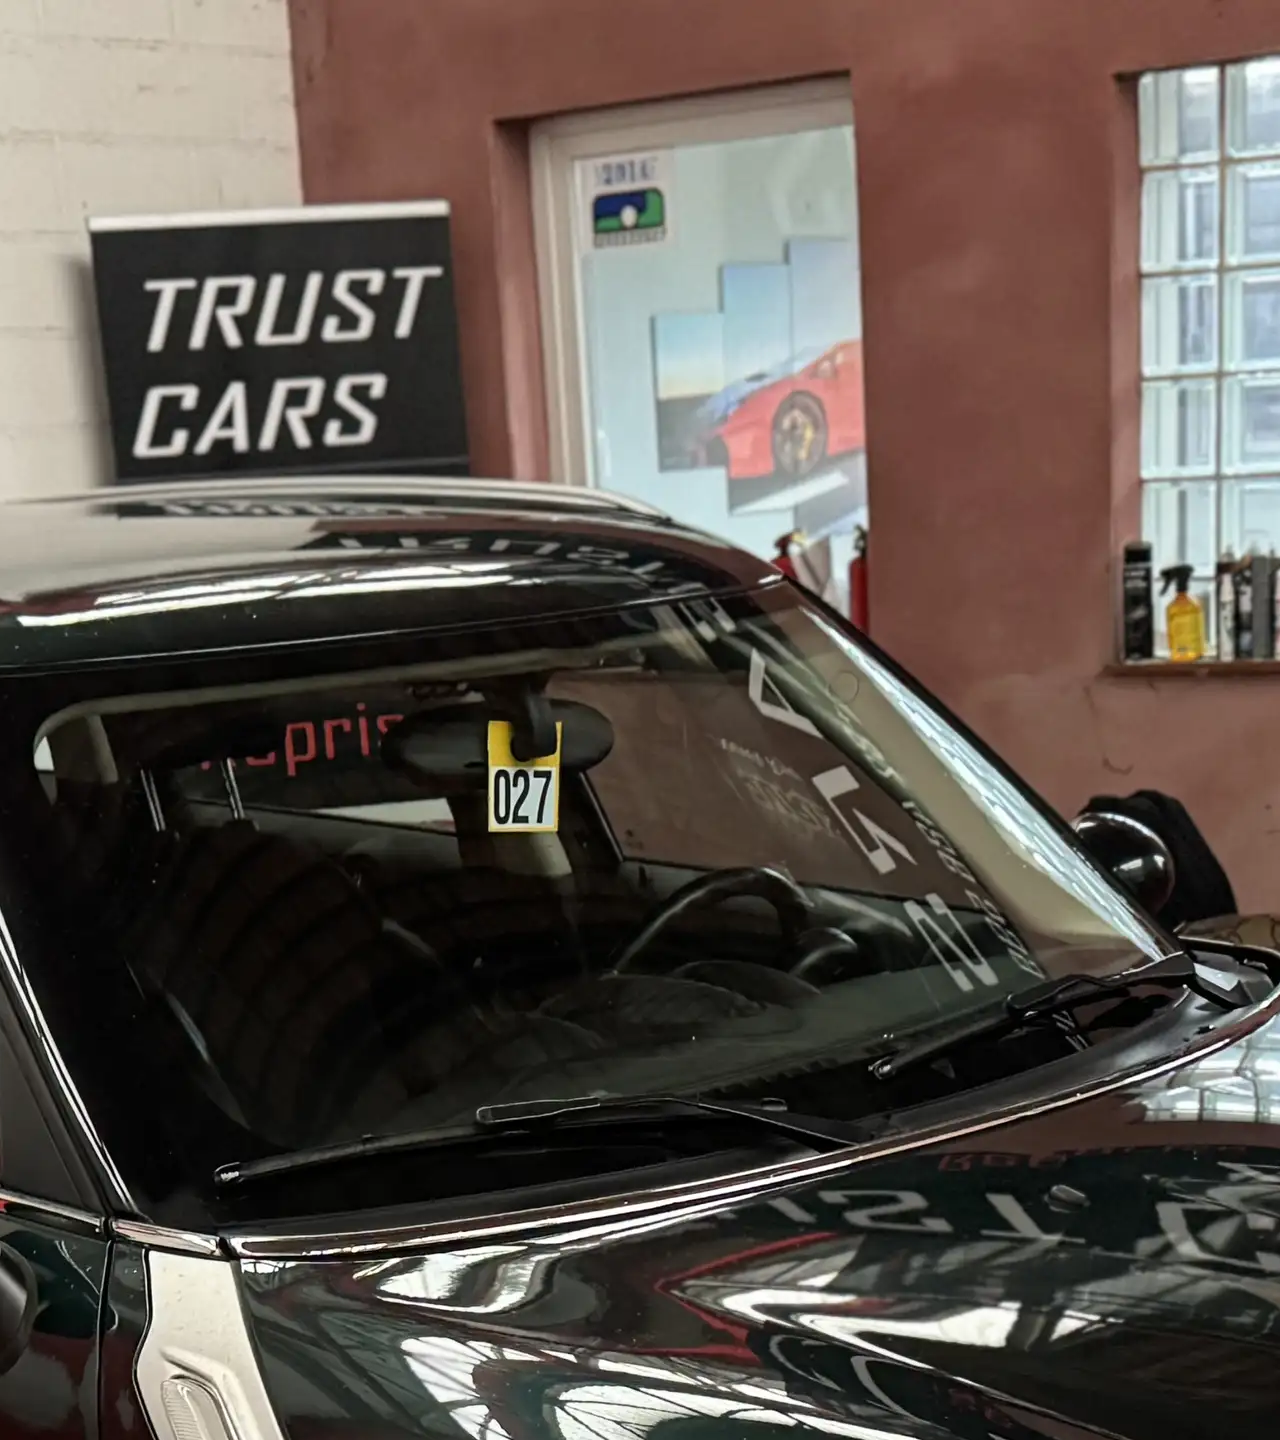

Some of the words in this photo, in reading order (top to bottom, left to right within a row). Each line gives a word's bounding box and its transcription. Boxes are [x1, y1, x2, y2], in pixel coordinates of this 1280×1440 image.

[142, 266, 443, 353] TRUST
[132, 373, 388, 459] CARS
[493, 768, 552, 826] 027
